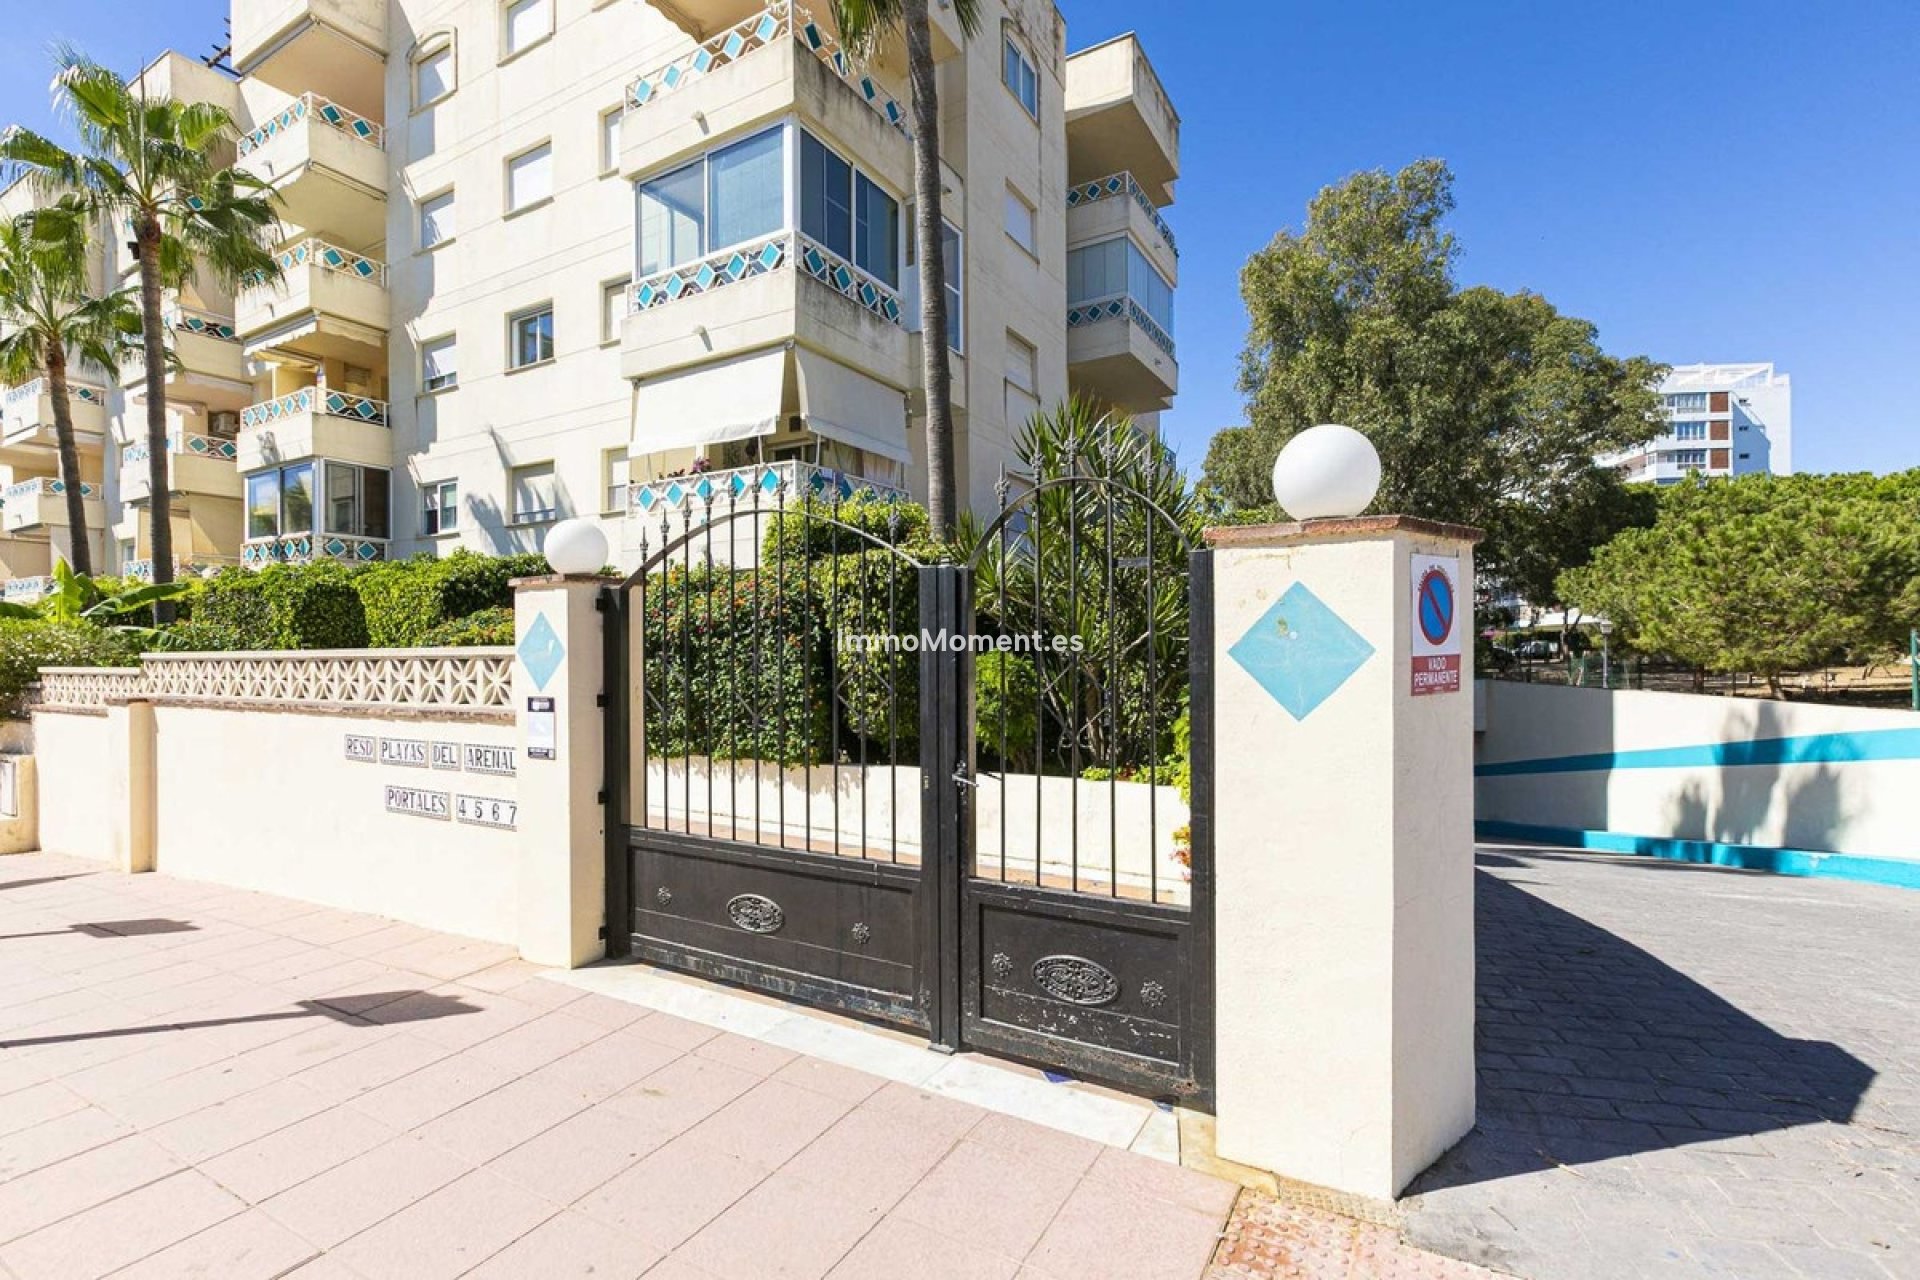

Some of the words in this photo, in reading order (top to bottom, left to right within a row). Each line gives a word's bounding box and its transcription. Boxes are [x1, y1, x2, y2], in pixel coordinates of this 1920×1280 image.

[1428, 657, 1447, 671] VADO
[1414, 670, 1458, 687] PERMANENTE
[381, 741, 425, 761] PLAYAS
[433, 745, 457, 764] DEL
[468, 748, 517, 770] ARENAL
[387, 788, 446, 813] PORTALES
[458, 799, 467, 816] 4
[475, 801, 483, 819] 5
[492, 803, 500, 821] 6
[509, 805, 517, 824] 7
